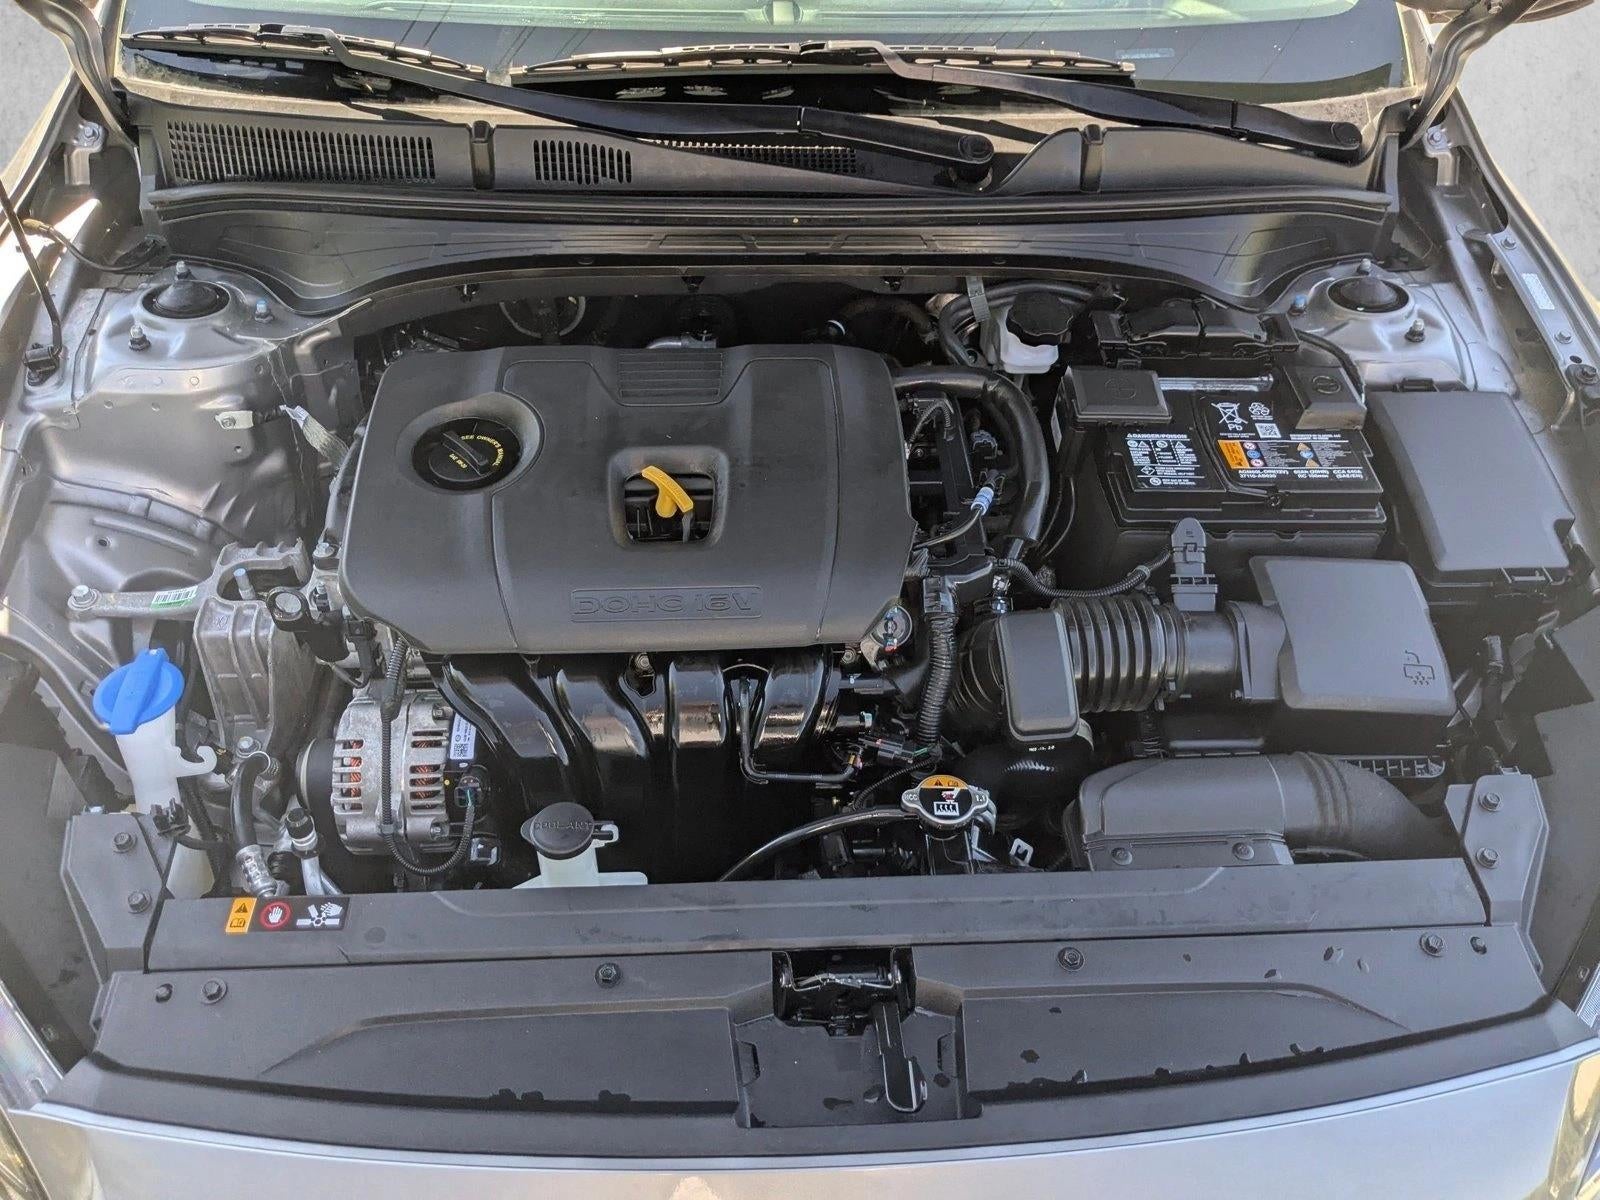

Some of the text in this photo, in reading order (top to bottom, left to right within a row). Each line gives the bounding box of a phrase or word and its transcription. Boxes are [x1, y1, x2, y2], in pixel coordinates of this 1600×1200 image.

[1227, 423, 1243, 431] Pb
[476, 435, 501, 448] OWNER'S
[492, 448, 504, 466] MANUAL
[573, 591, 757, 615] DOHC 16V
[534, 820, 593, 830] COOLANT
